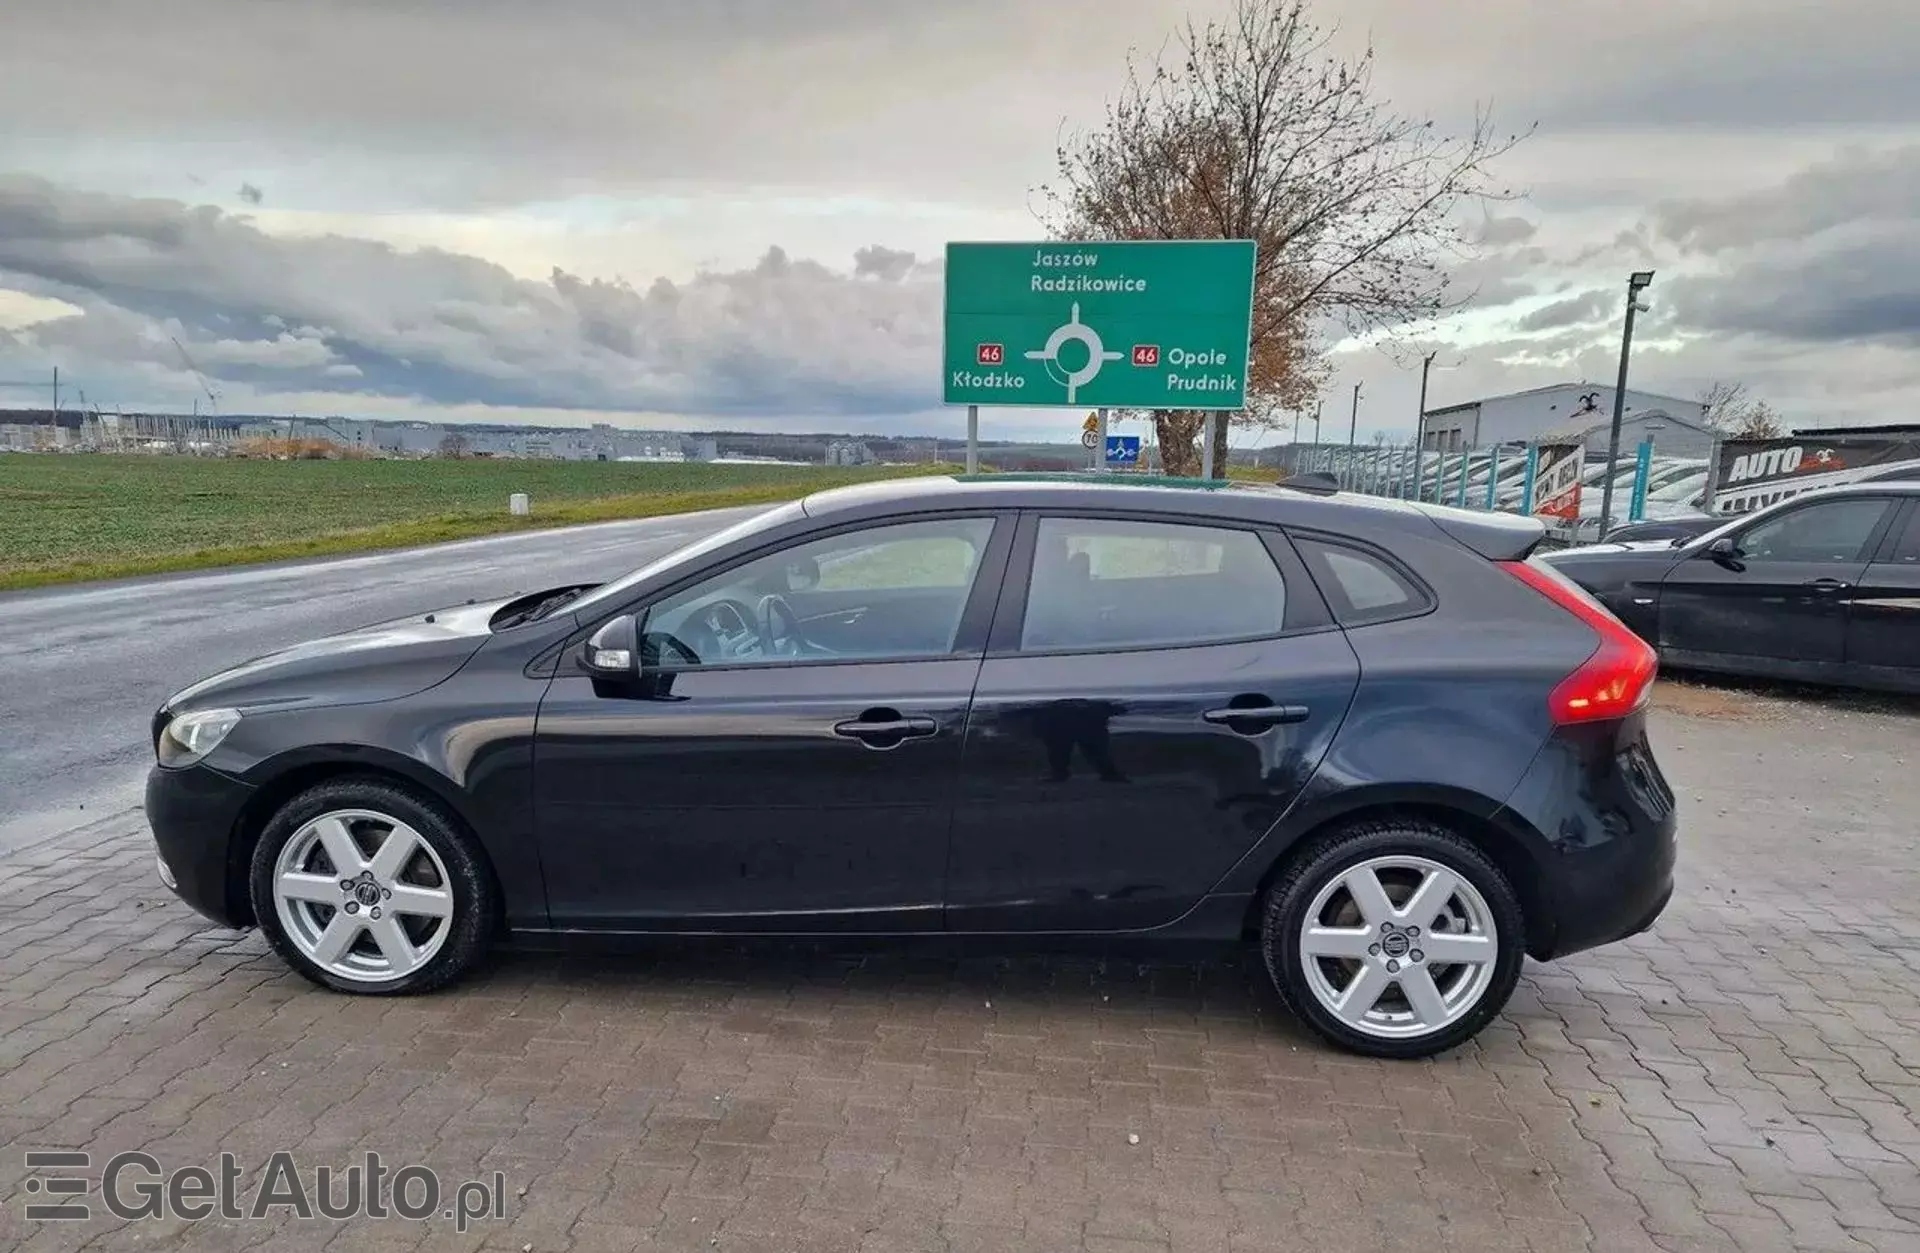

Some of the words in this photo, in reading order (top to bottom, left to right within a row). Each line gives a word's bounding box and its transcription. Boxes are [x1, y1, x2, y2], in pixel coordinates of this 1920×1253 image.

[1032, 250, 1098, 267] Jaszów
[1031, 275, 1147, 292] Radzikowice
[981, 347, 999, 361] 46
[1136, 348, 1156, 362] 46
[1168, 348, 1227, 369] Opole
[952, 371, 1025, 388] Kłodzko
[1167, 373, 1237, 391] Prudnik
[1728, 446, 1803, 483] AUTO
